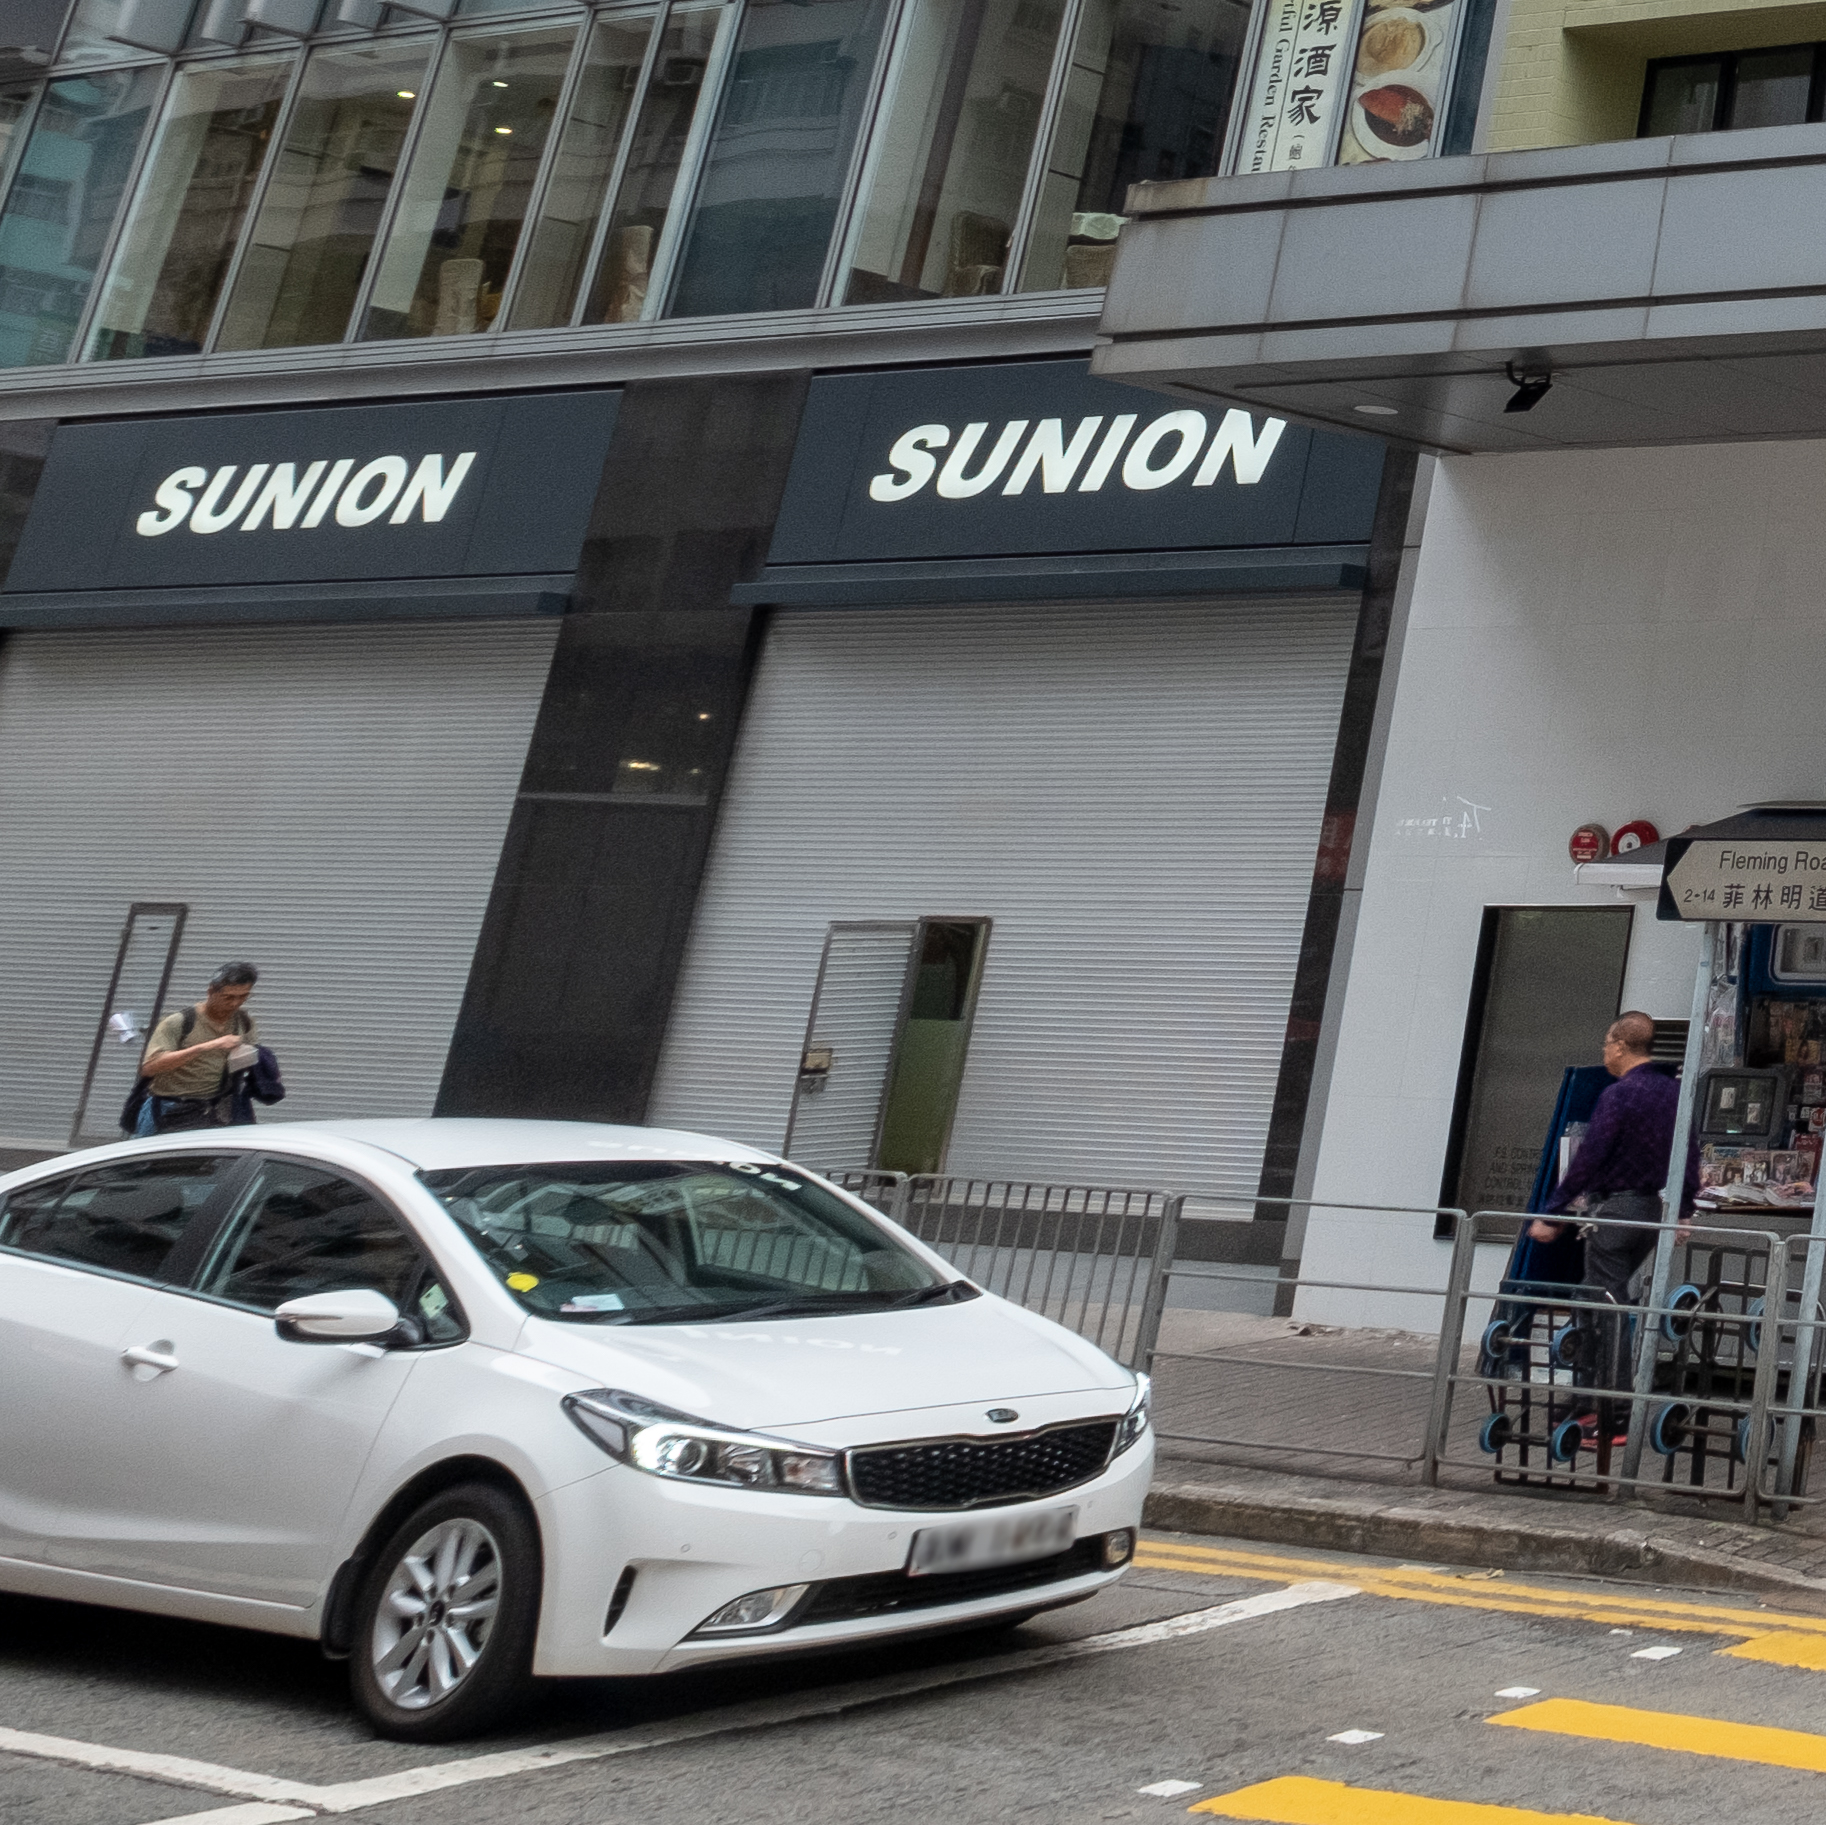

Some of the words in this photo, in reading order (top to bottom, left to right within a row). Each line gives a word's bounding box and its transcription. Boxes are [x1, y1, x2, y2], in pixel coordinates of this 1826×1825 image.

[1263, 38, 1291, 106] Garden
[134, 451, 477, 540] SUNION
[867, 408, 1287, 505] SUNION
[1718, 850, 1789, 874] Fleming
